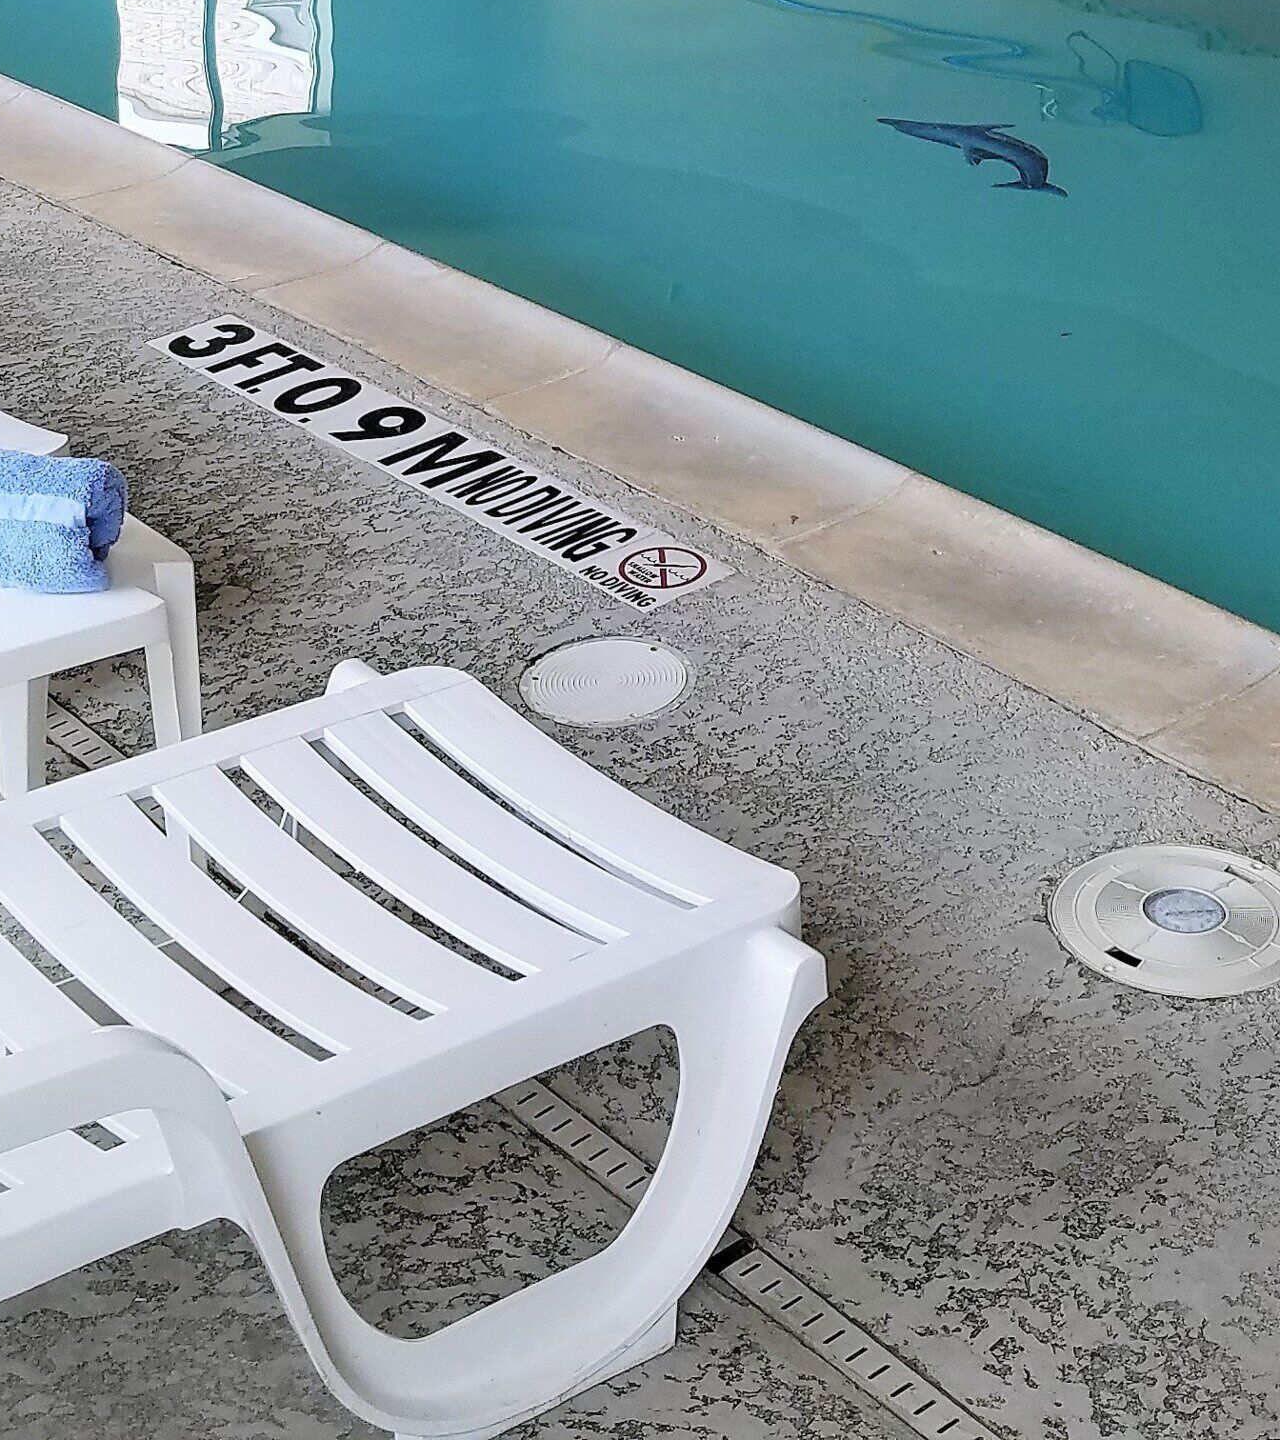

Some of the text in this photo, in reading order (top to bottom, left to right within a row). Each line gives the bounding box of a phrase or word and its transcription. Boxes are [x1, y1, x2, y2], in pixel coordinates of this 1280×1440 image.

[168, 323, 255, 359] 3
[378, 431, 505, 489] M
[452, 465, 538, 516] NO
[484, 485, 638, 561] DIVING
[580, 565, 656, 607] NO DIVING
